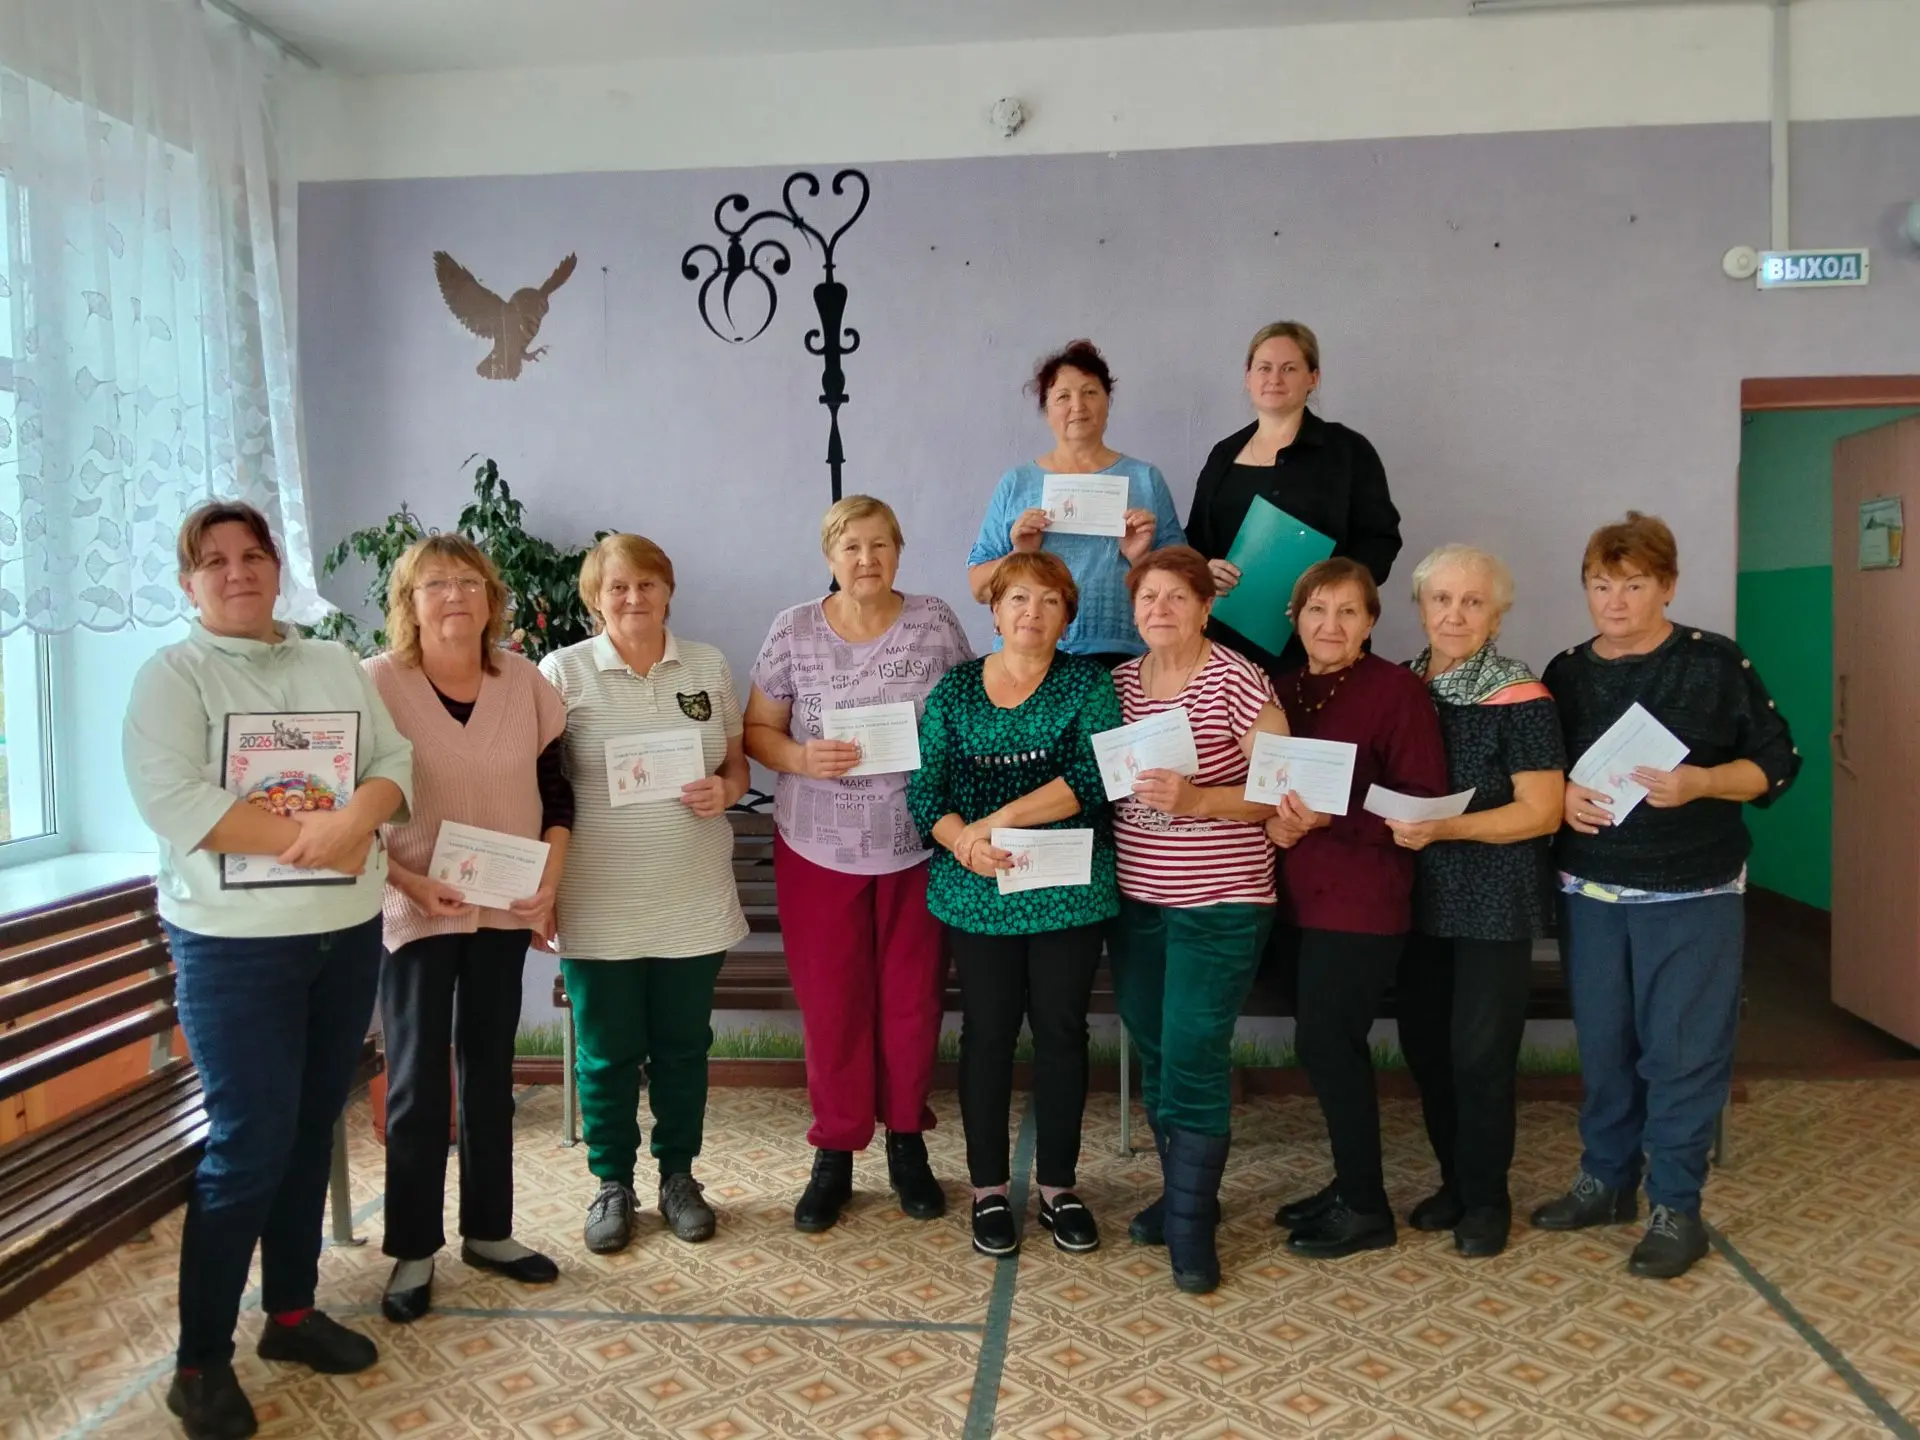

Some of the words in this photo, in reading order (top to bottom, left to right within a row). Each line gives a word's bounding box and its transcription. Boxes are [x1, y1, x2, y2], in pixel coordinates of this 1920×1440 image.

[1769, 256, 1858, 280] ВЫХОД
[885, 642, 916, 656] MAKE
[239, 735, 272, 749] 2026
[280, 770, 305, 779] 2026
[839, 778, 873, 788] MAKE
